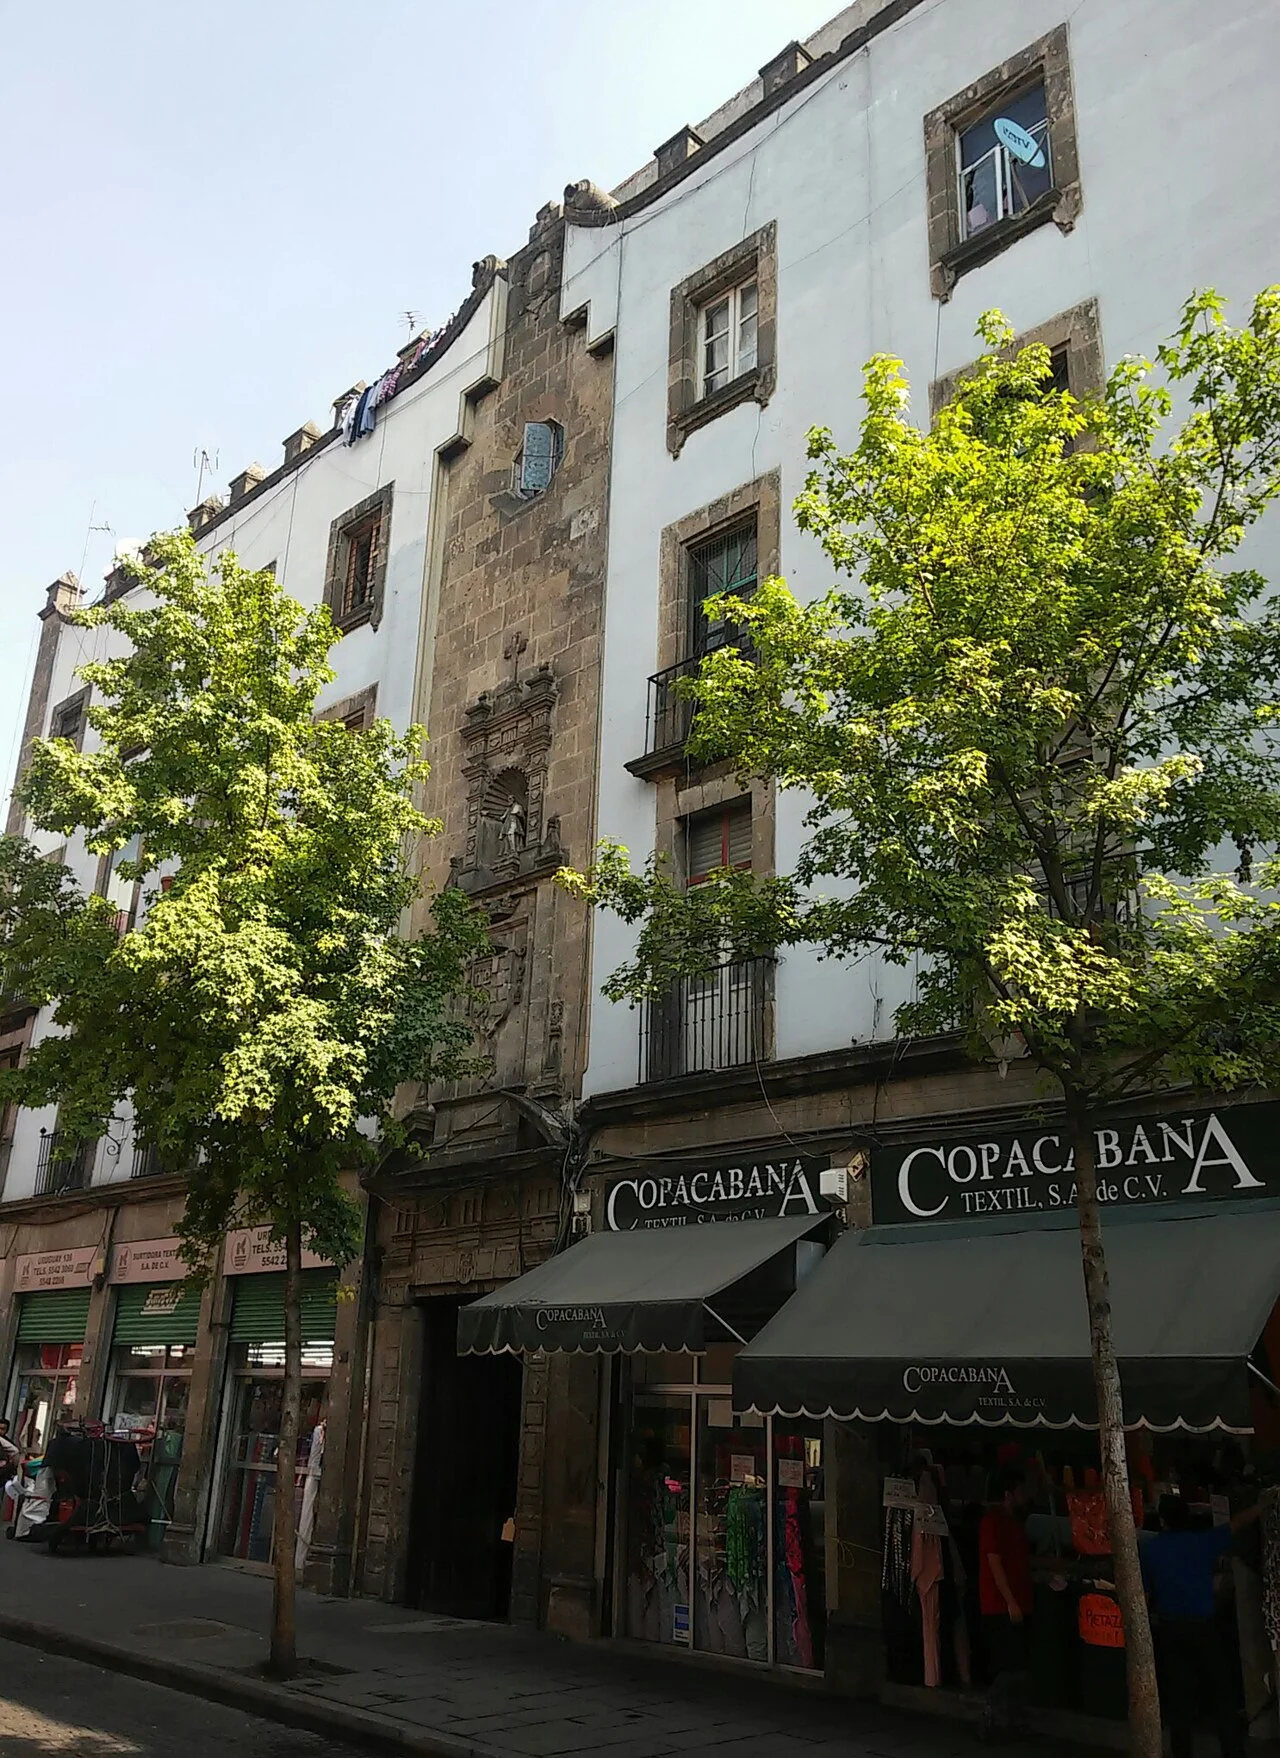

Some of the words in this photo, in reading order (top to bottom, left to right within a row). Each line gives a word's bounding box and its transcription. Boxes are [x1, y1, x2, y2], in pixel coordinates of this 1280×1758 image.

[607, 1159, 819, 1231] COPACABANA
[1049, 1185, 1078, 1206] S.A
[1096, 1178, 1119, 1202] de
[1123, 1175, 1168, 1198] C.V.
[536, 1307, 608, 1331] COPACABANA
[902, 1365, 1017, 1394] COPACABANA
